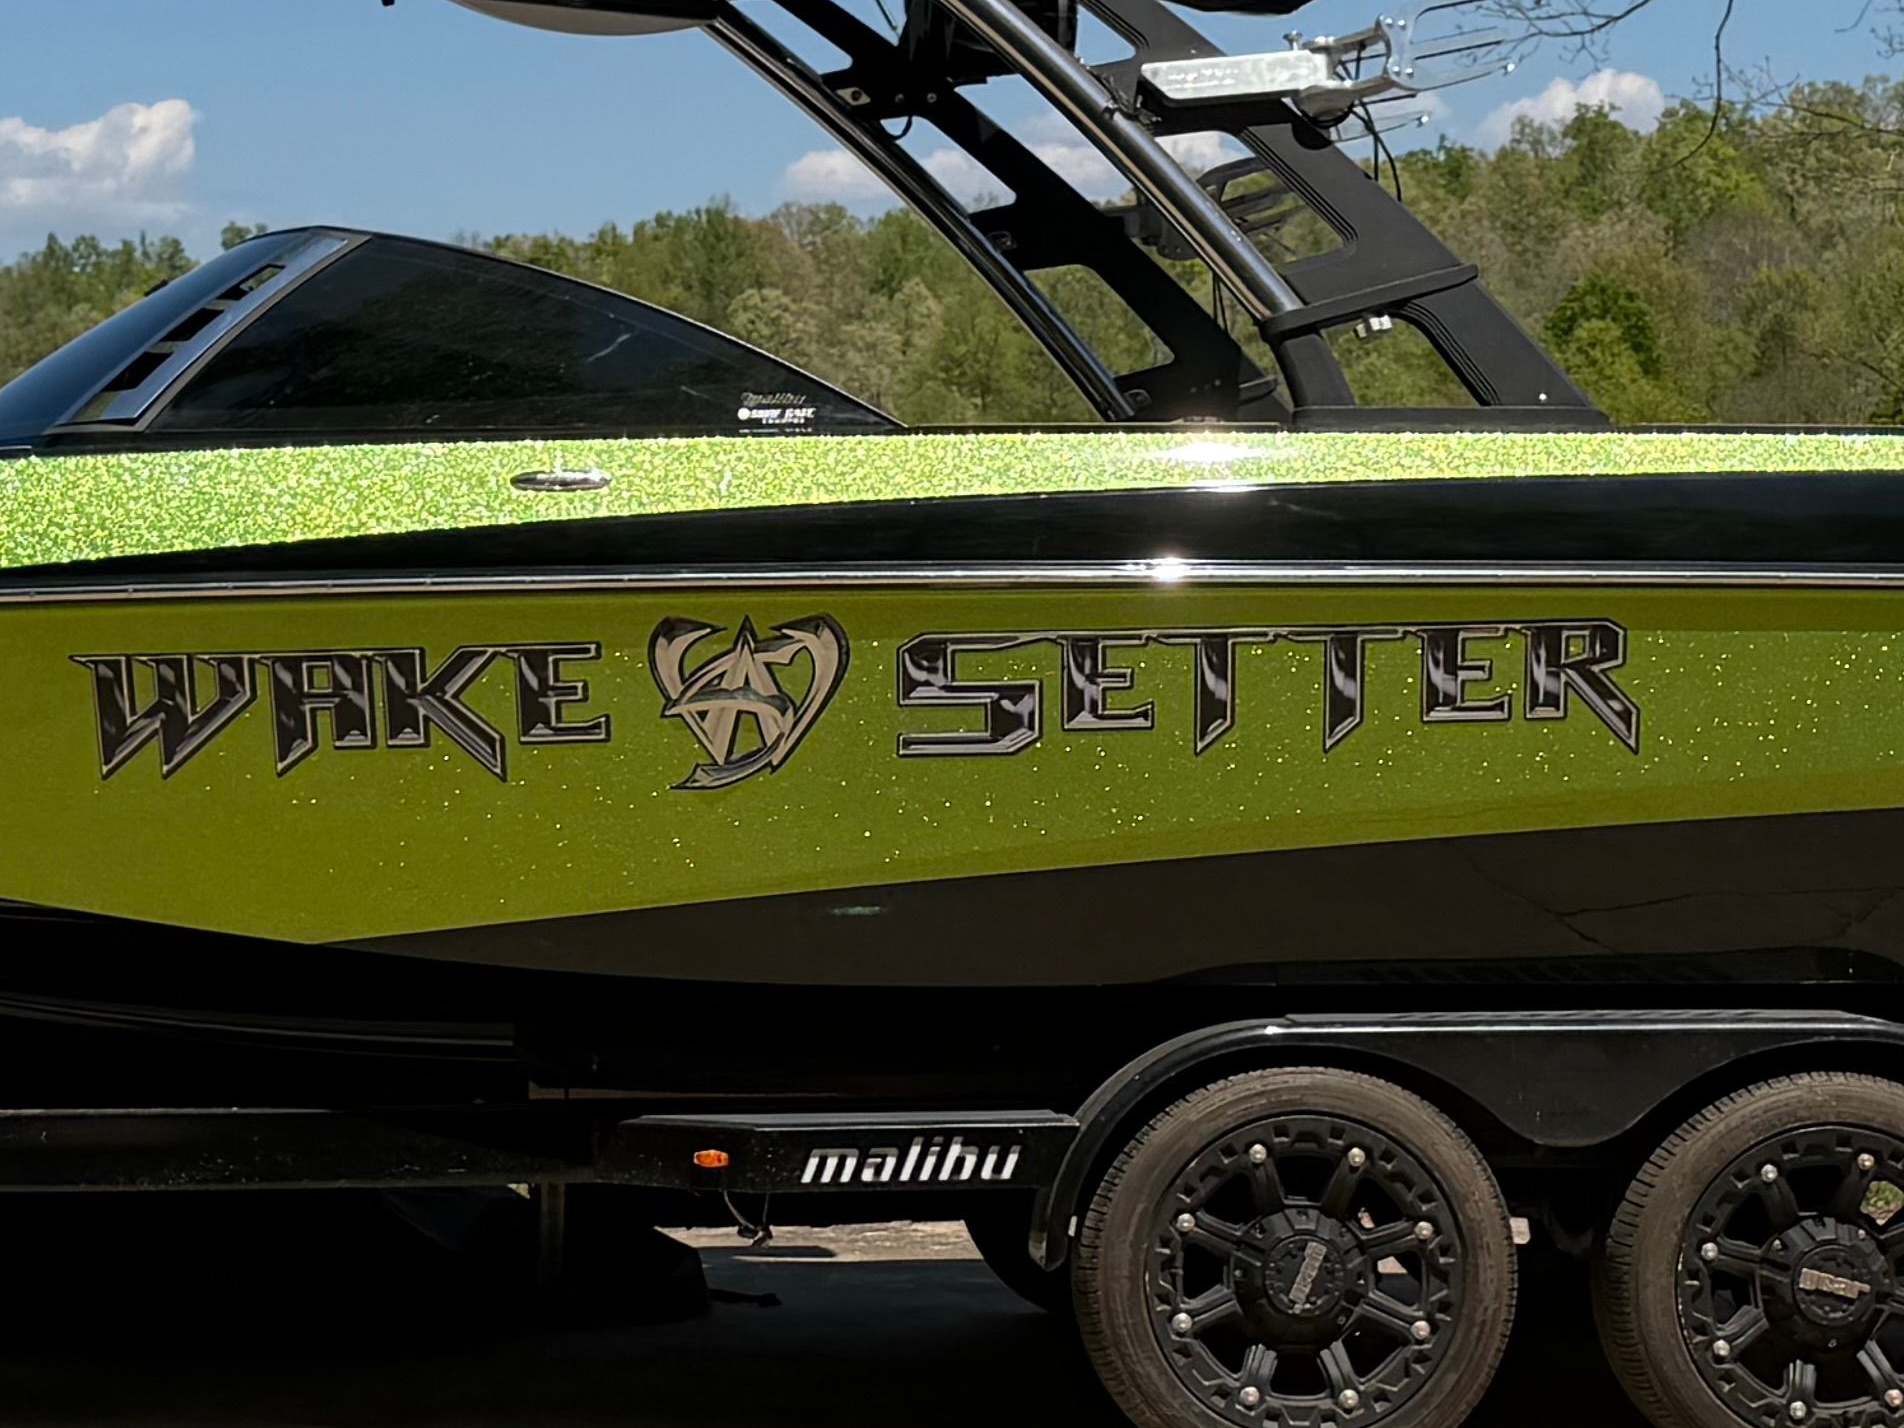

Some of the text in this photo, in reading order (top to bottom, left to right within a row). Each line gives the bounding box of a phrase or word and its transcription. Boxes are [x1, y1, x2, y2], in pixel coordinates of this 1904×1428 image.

[69, 643, 612, 783] WAKE
[898, 619, 1640, 756] SETTER
[800, 1136, 1022, 1184] malibu
